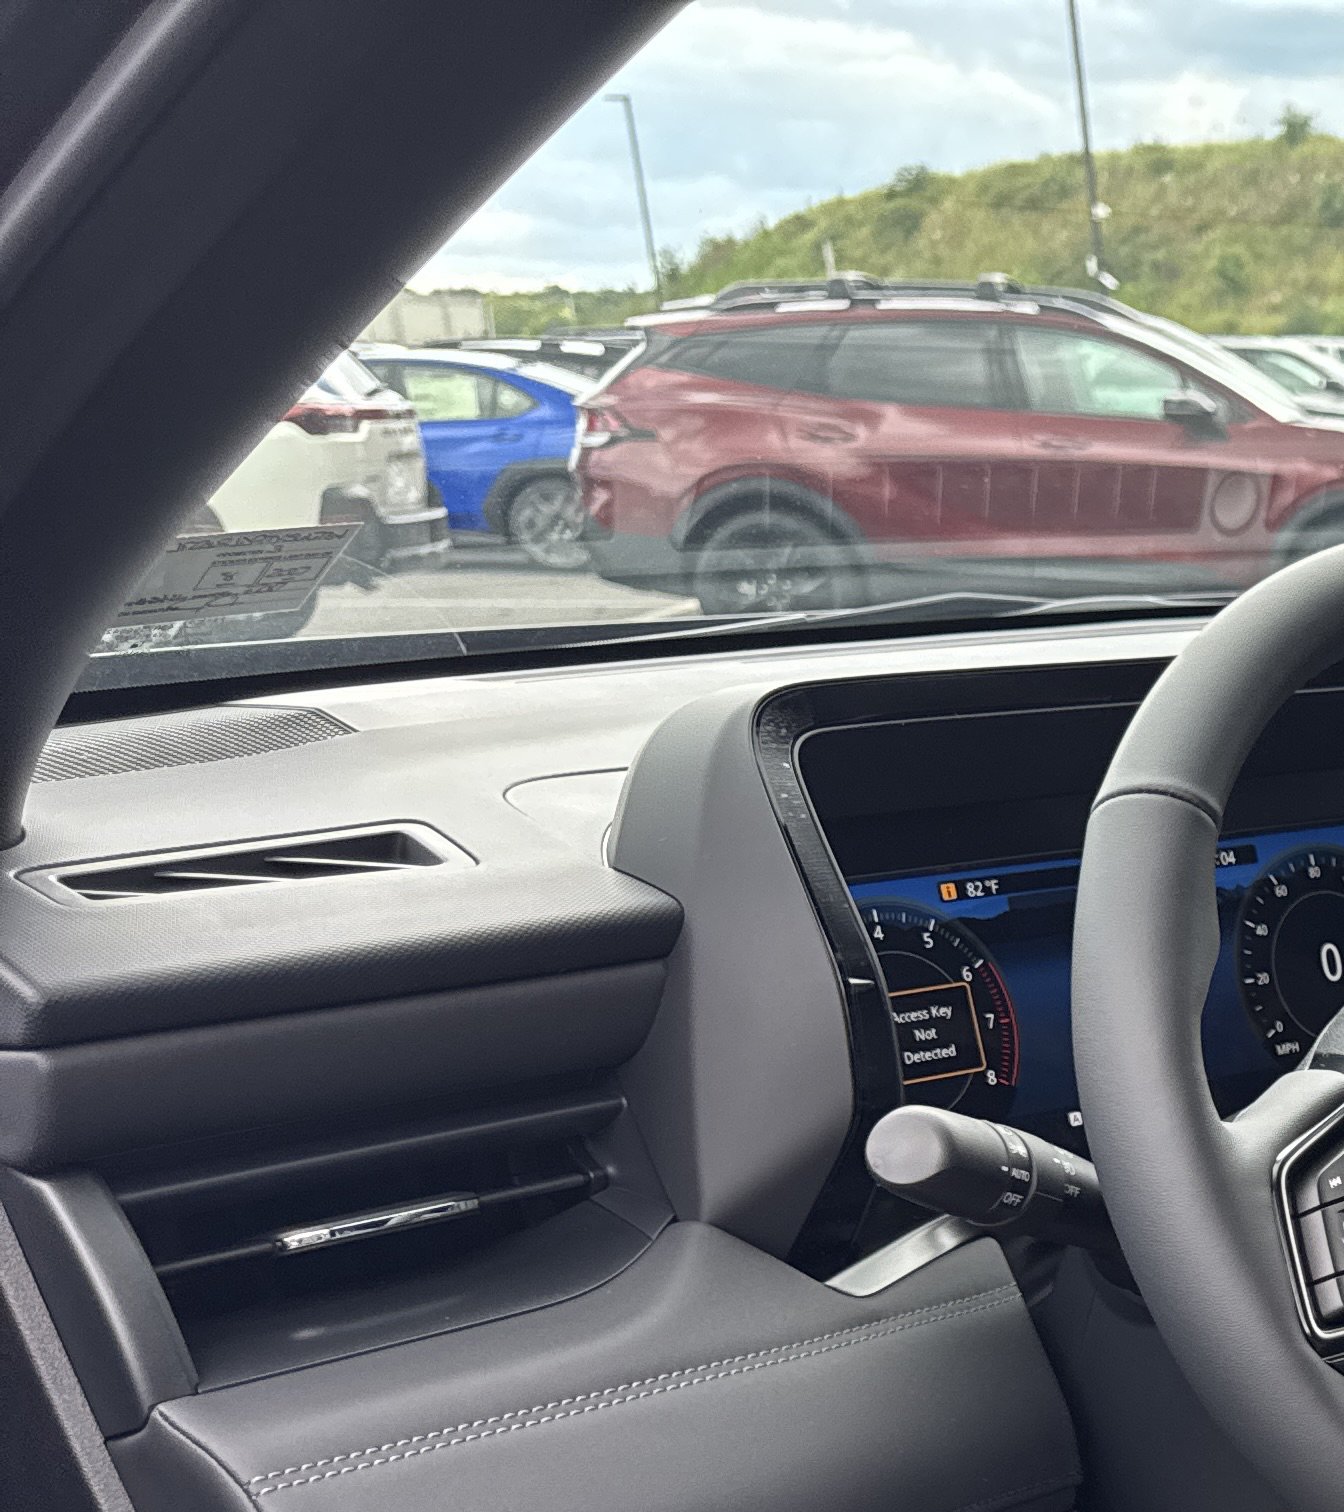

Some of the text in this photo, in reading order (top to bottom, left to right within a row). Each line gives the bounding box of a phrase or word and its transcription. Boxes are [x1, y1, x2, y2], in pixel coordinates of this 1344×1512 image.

[1308, 866, 1321, 878] 80
[966, 879, 999, 897] 82°F
[1275, 885, 1288, 897] 60
[873, 925, 885, 941] 4
[1256, 924, 1269, 936] 40
[922, 932, 934, 949] 5
[1320, 942, 1343, 983] 0
[961, 965, 973, 982] 6
[1256, 973, 1270, 985] 20
[892, 1005, 953, 1025] Access Key
[984, 1013, 995, 1030] 7
[914, 1026, 938, 1042] Not
[1275, 1020, 1284, 1033] 0
[903, 1043, 957, 1065] Detected
[1275, 1041, 1300, 1057] MPH
[986, 1069, 998, 1086] 8
[1011, 1168, 1030, 1183] AUTO
[1002, 1191, 1025, 1206] OFF
[1064, 1184, 1081, 1198] OFF
